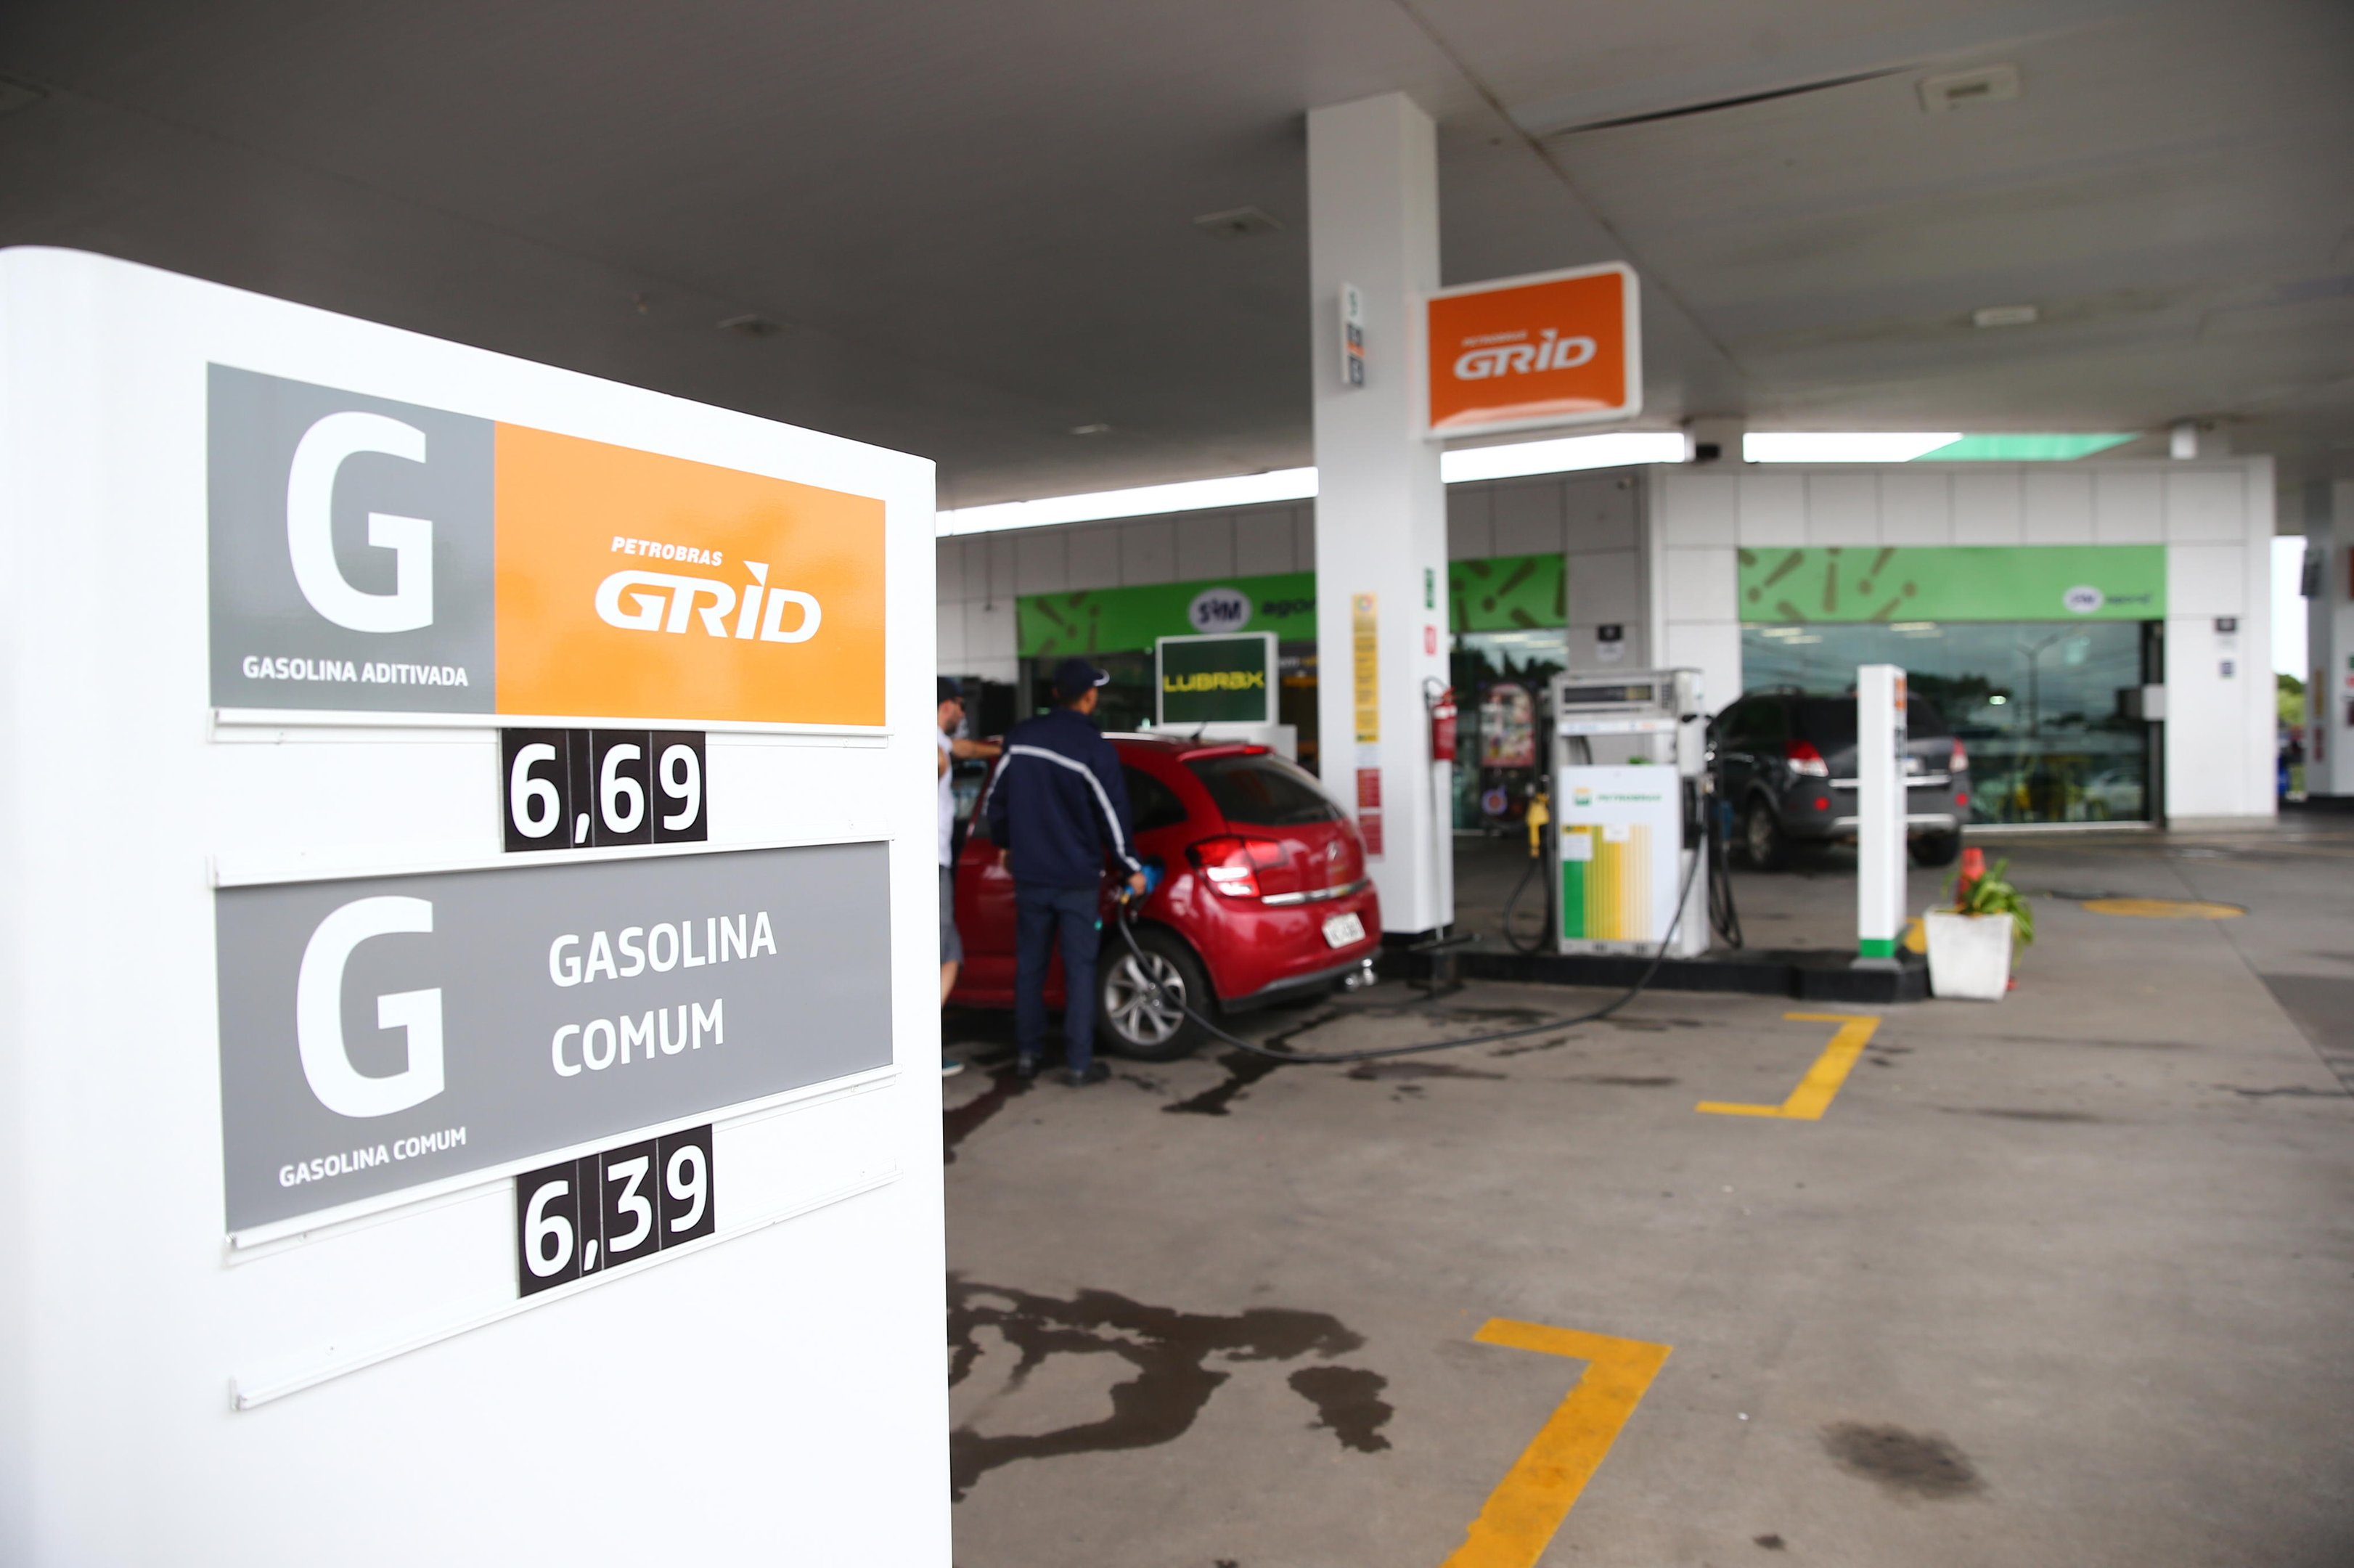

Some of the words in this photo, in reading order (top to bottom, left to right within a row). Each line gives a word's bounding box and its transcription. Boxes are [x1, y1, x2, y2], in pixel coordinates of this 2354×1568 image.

[1454, 328, 1596, 380] GRID
[287, 410, 433, 633] G
[610, 536, 723, 567] PETROBRAS
[594, 560, 822, 644] GRID
[242, 655, 358, 683] GASOLINA
[361, 661, 469, 687] ADITIVADA
[510, 743, 700, 844] 6,69
[549, 911, 777, 987] GASOLINA
[296, 895, 445, 1118] G
[552, 998, 724, 1077] COMUM
[279, 1144, 389, 1187] GASOLINA
[393, 1127, 467, 1160] COMUM
[524, 1144, 708, 1278] 6,39
